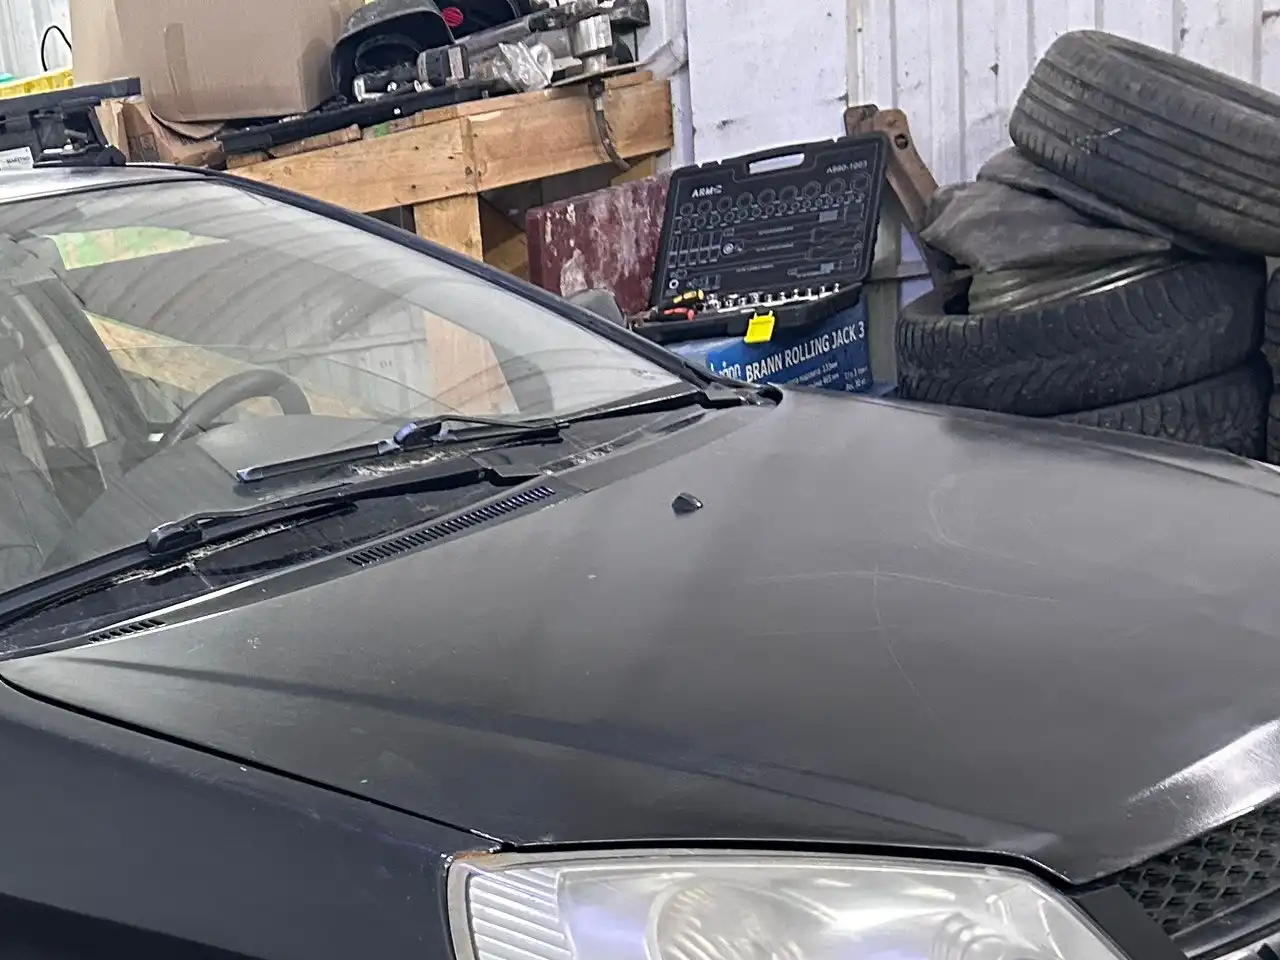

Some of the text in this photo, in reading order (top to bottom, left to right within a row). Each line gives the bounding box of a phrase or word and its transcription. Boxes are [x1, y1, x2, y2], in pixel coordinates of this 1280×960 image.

[745, 353, 783, 382] BRANN
[784, 334, 830, 367] ROLLING
[832, 323, 857, 349] JACK
[858, 320, 865, 338] 3
